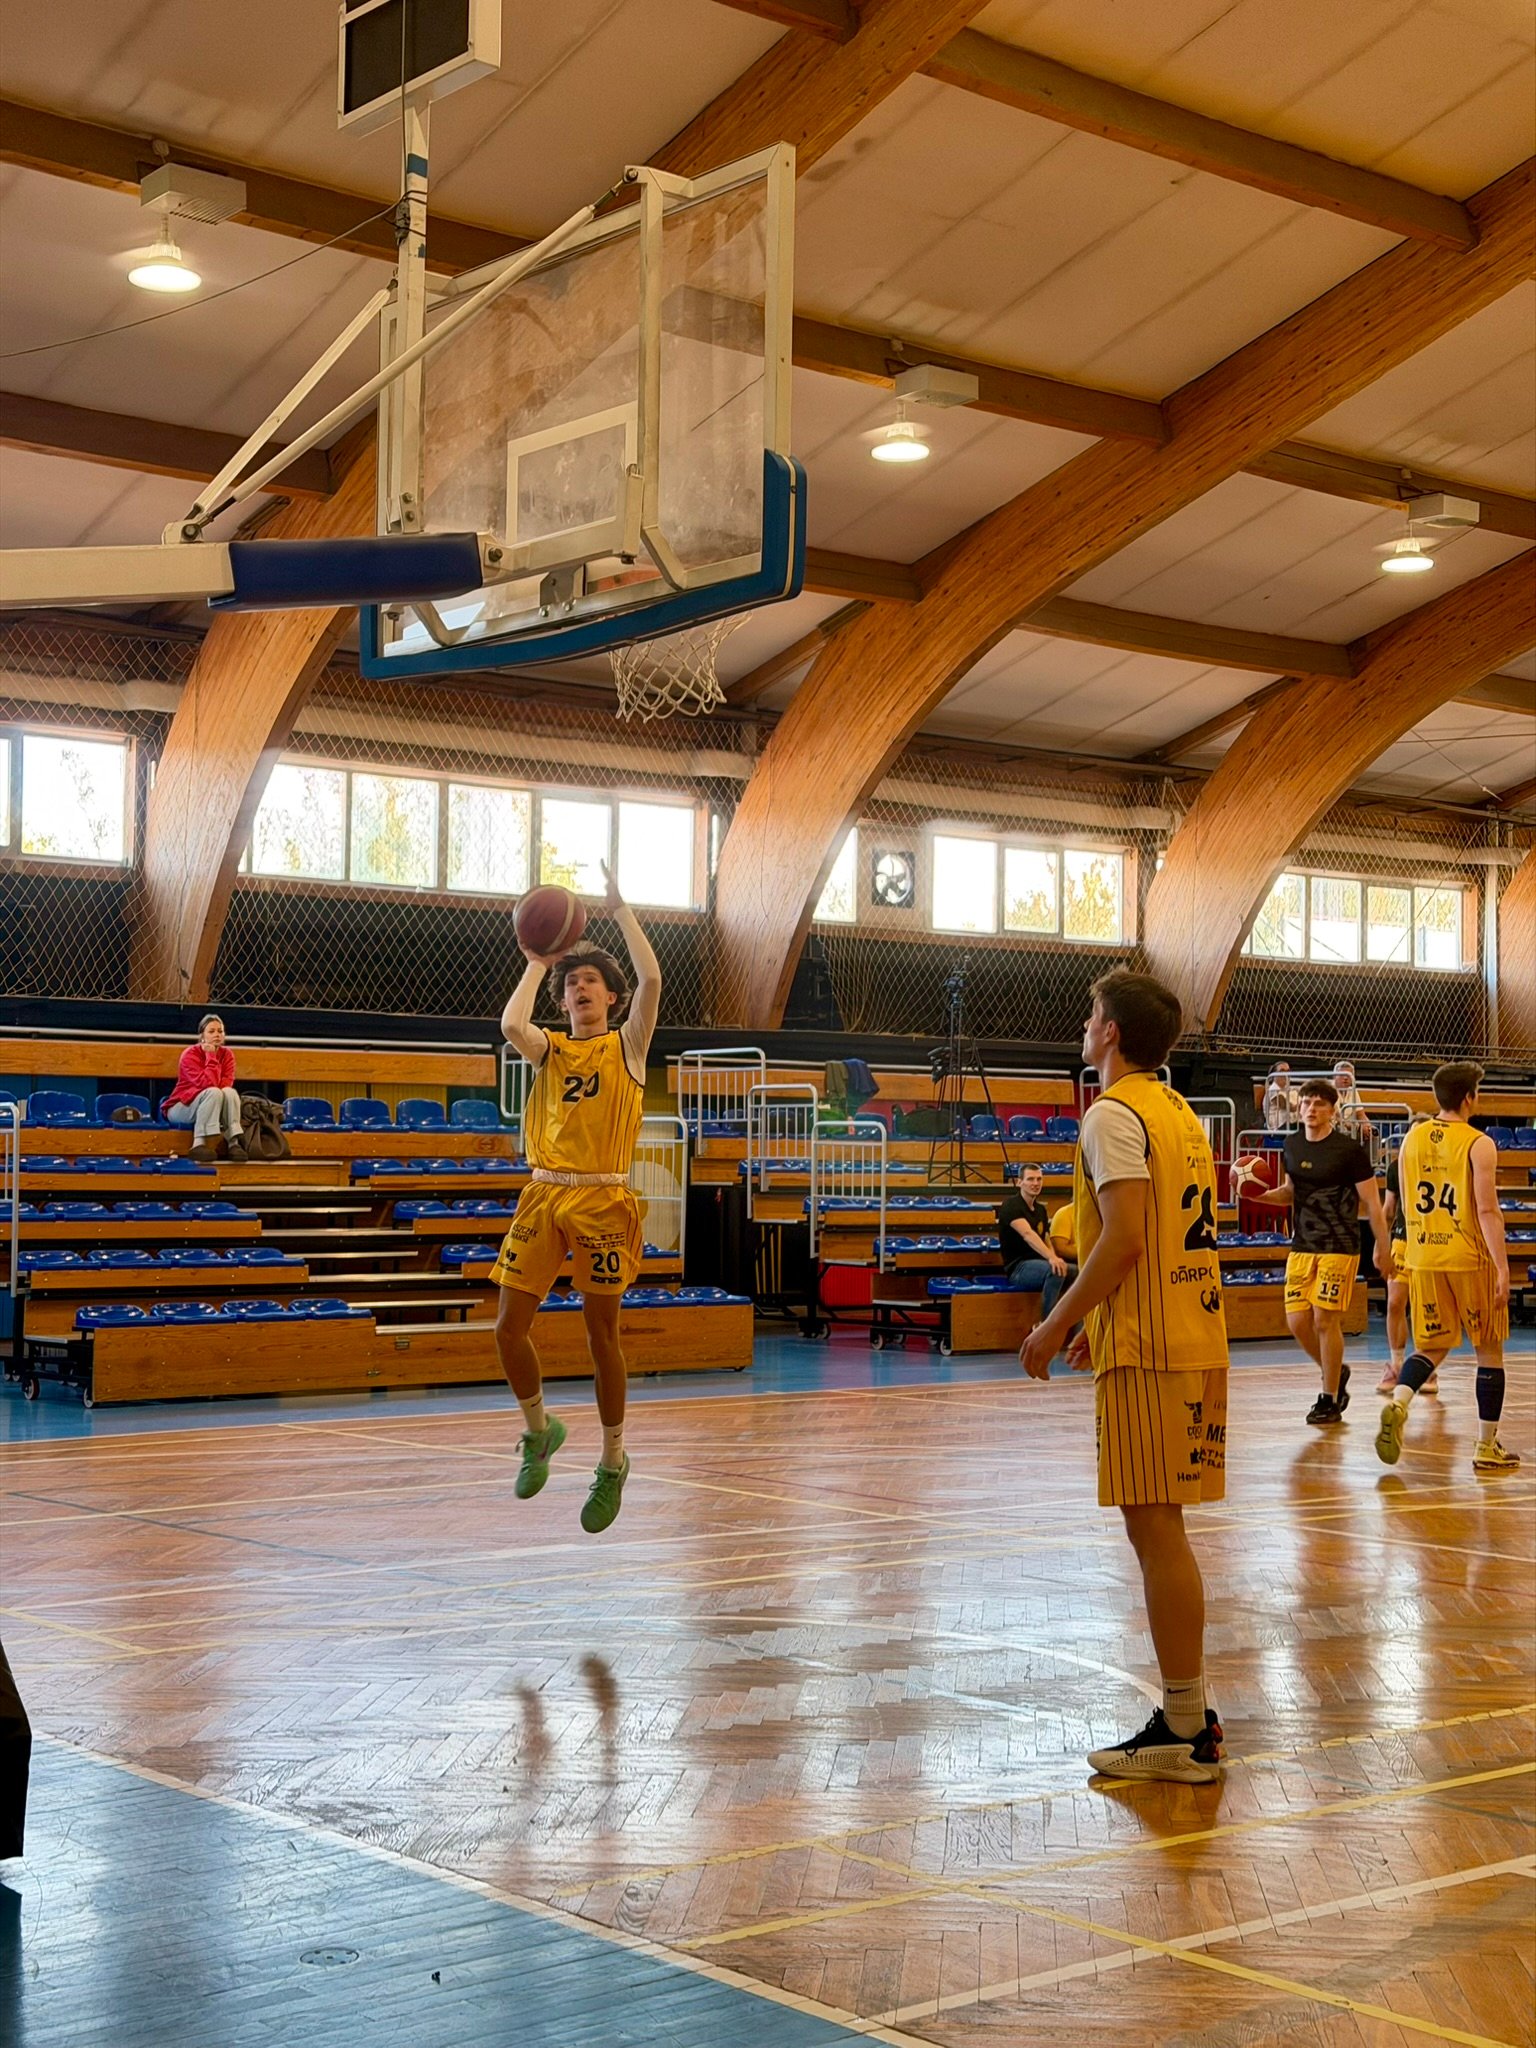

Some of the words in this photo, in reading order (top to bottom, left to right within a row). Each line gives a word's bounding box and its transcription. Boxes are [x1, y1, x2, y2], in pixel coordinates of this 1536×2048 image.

[1415, 1181, 1457, 1216] 34
[591, 1251, 620, 1273] 20
[1320, 1282, 1340, 1296] 15
